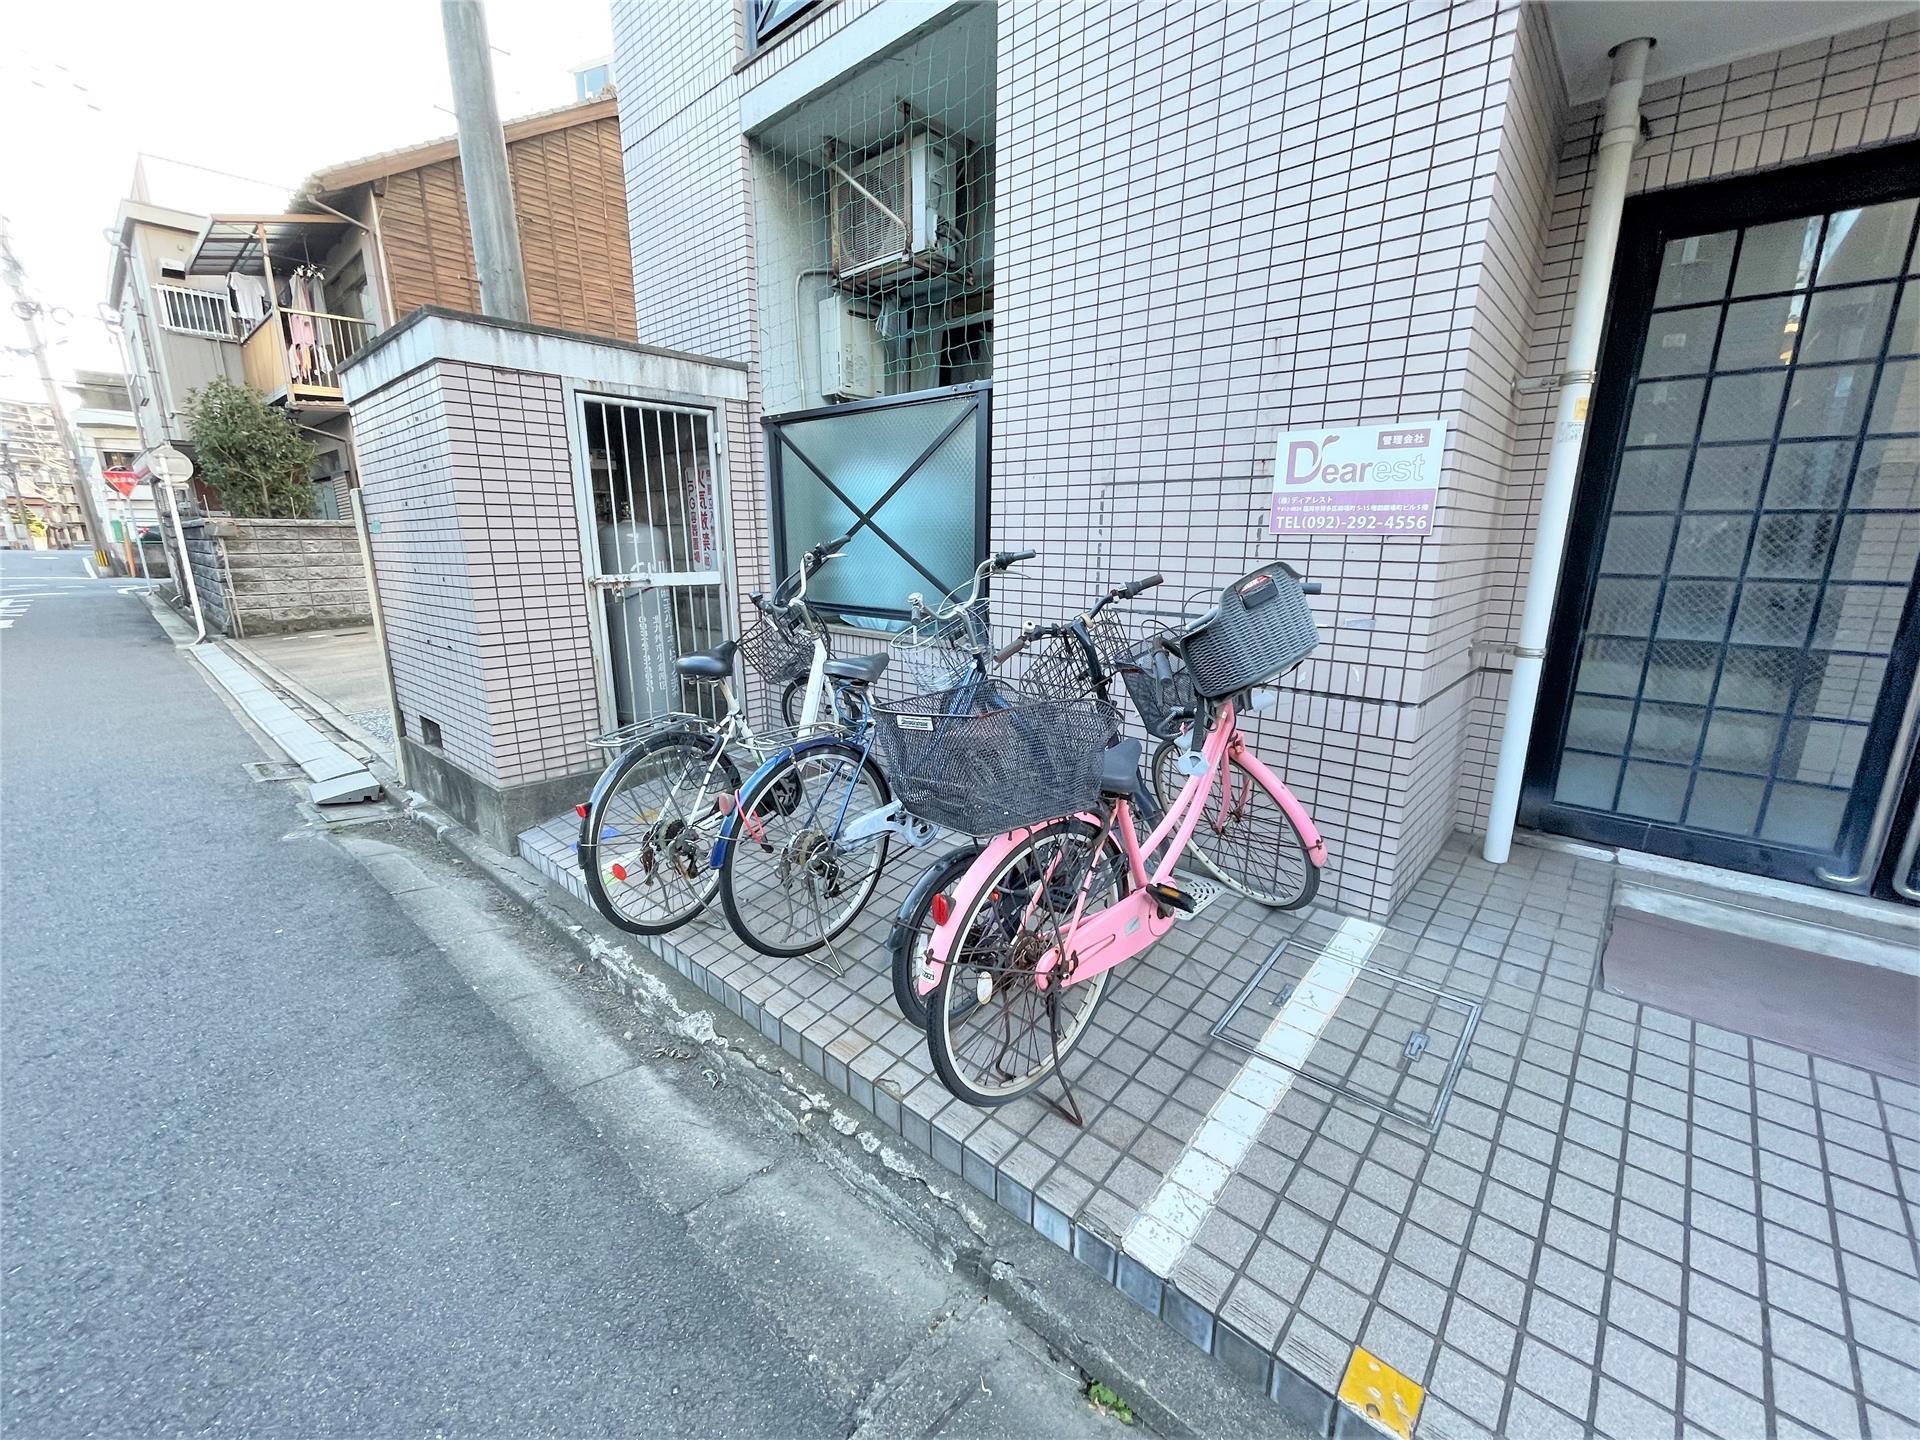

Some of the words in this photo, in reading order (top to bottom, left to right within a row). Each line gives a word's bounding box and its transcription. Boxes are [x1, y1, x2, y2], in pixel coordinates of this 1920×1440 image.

[1382, 434, 1425, 446] 管理会社
[1276, 515, 1427, 529] TEL(092)-292-4556
